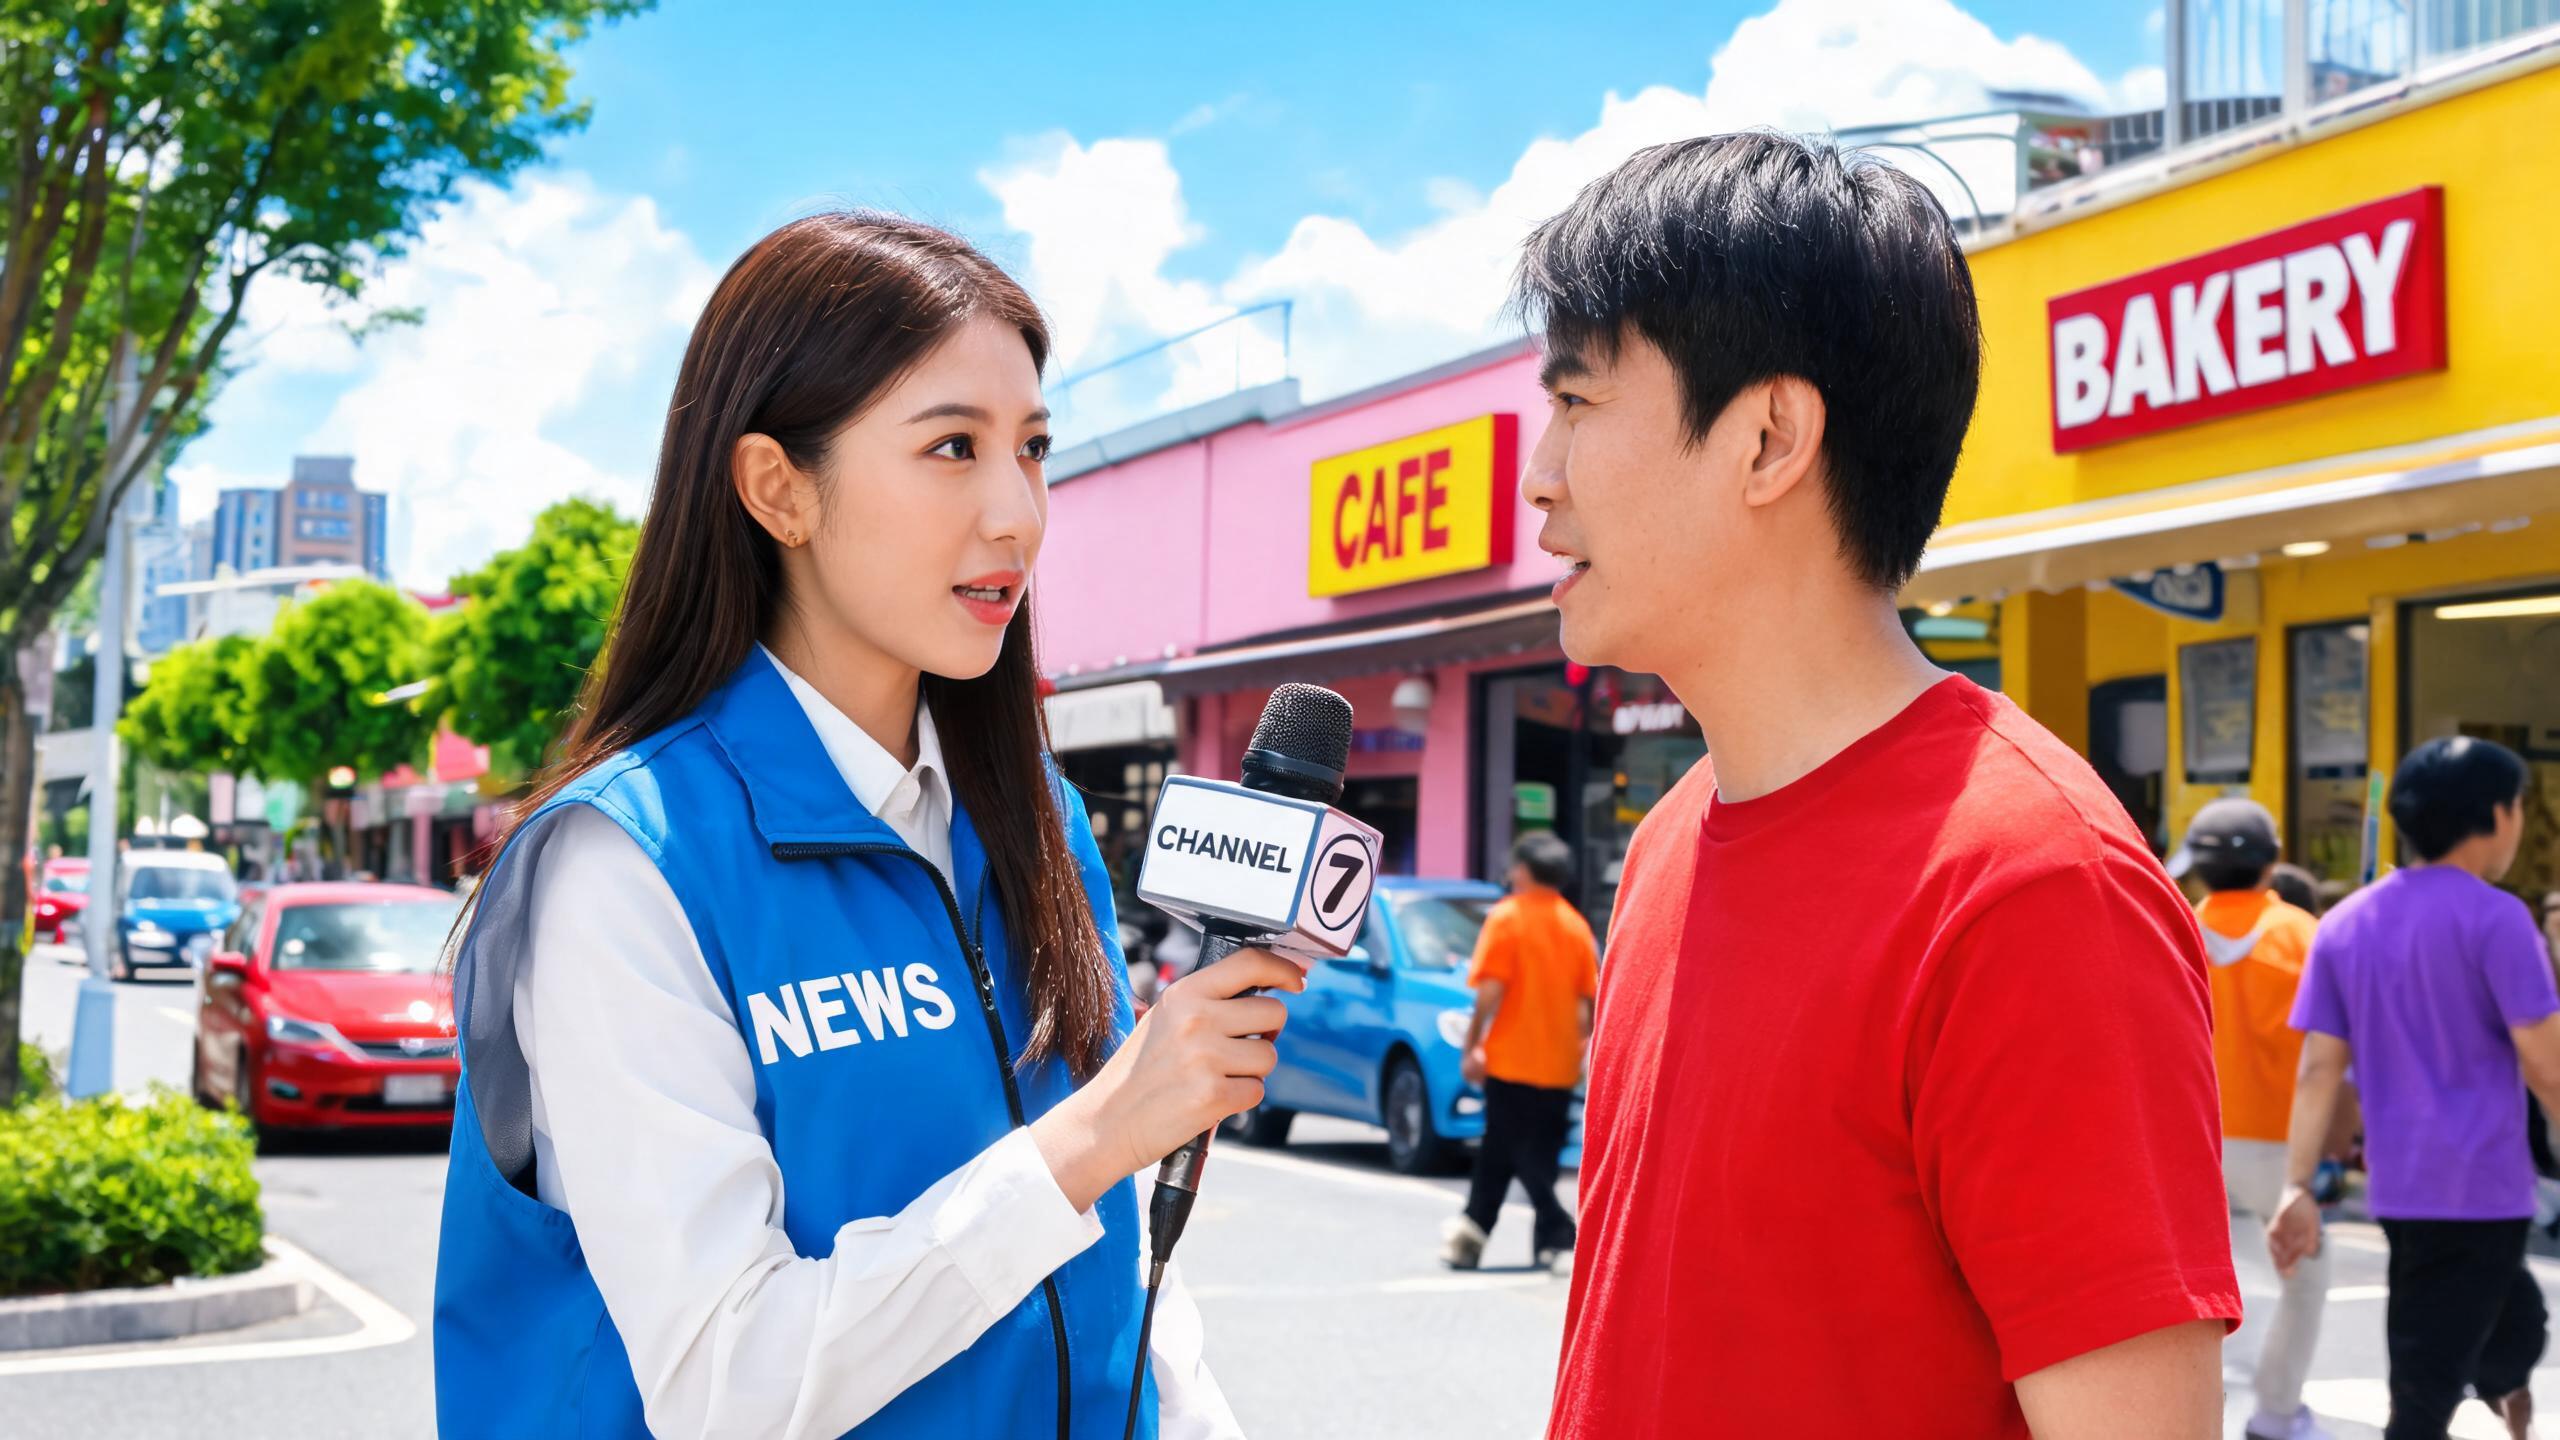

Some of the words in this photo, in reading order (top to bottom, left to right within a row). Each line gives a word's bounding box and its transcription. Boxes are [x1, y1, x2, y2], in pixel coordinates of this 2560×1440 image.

[2053, 218, 2415, 429] BAKERY
[1333, 447, 1452, 571] CAFE
[1157, 825, 1292, 874] CHANNEL
[1322, 852, 1364, 914] 7
[747, 962, 956, 1065] NEWS
